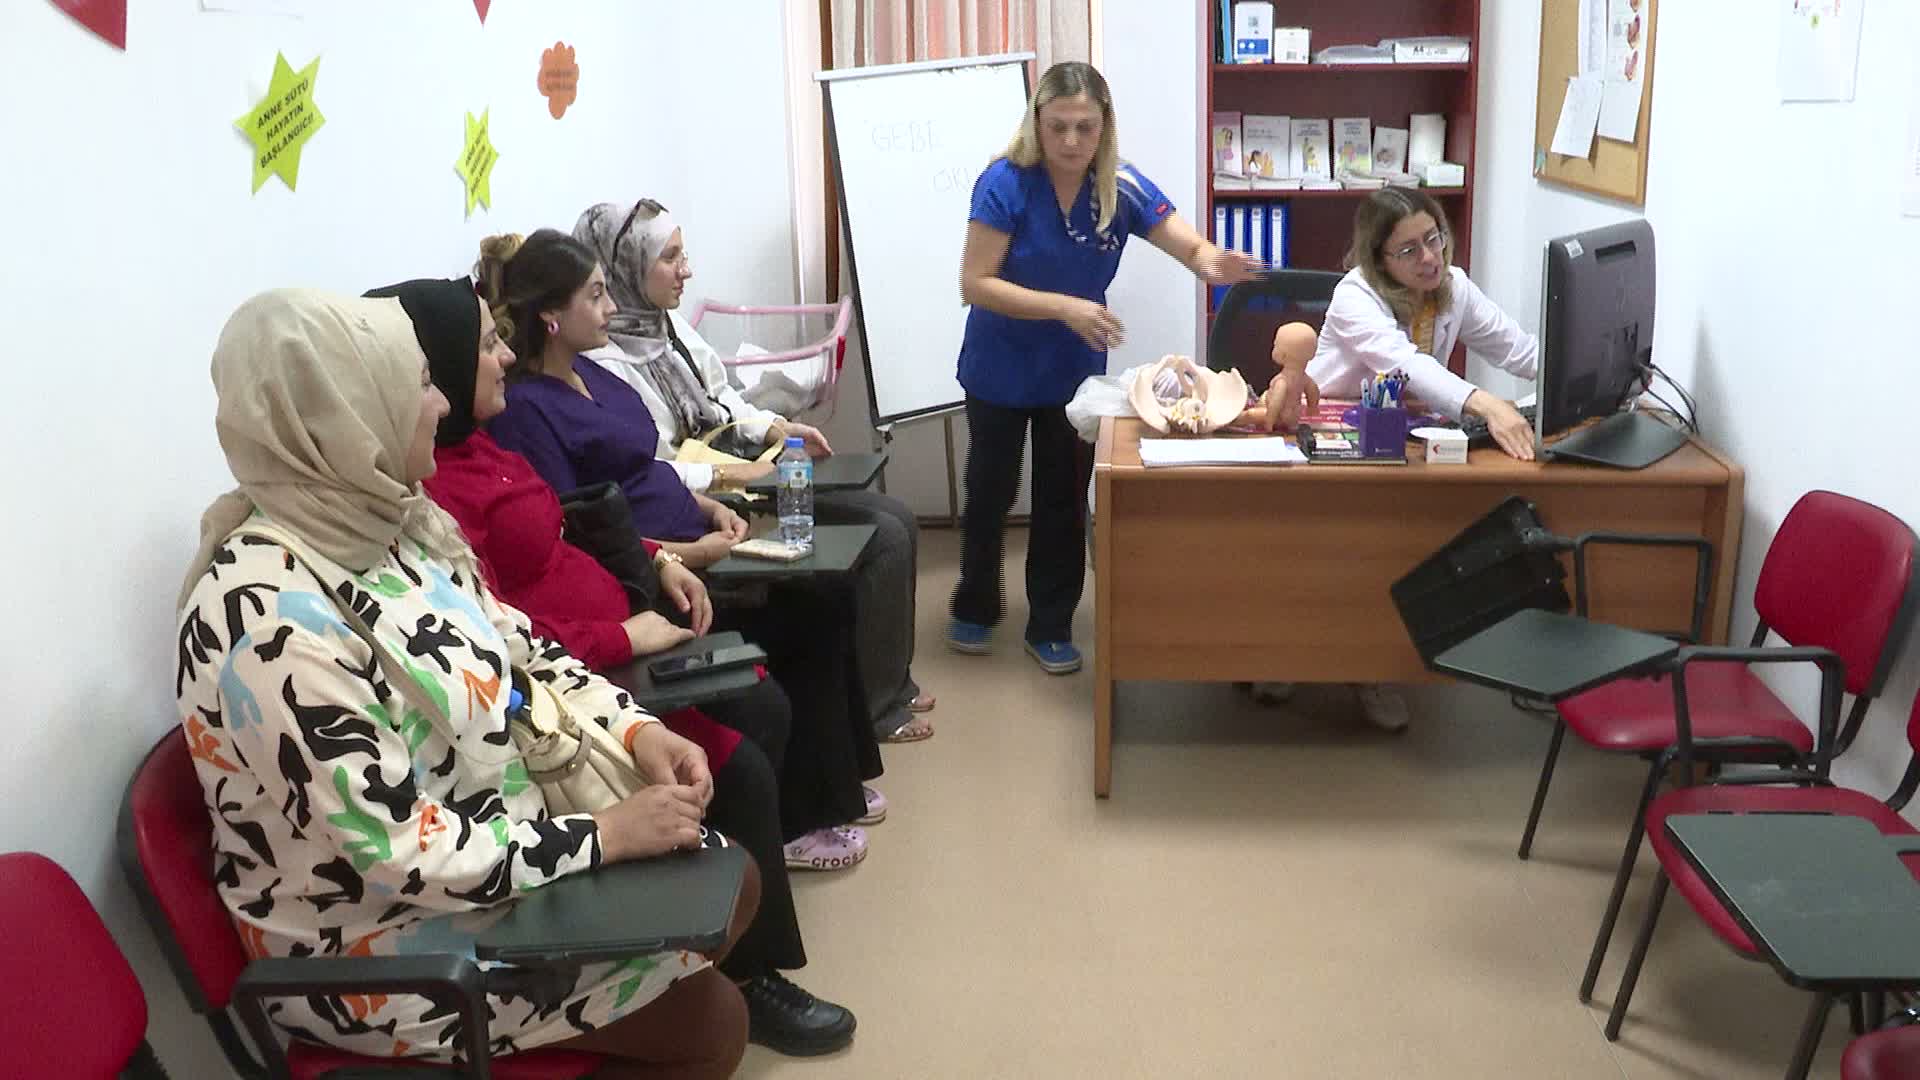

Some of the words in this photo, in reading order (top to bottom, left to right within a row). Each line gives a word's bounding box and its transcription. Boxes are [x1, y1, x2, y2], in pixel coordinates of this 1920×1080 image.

[257, 100, 283, 128] ANNE
[266, 101, 304, 141] HAYATIN
[812, 852, 858, 868] crocs
